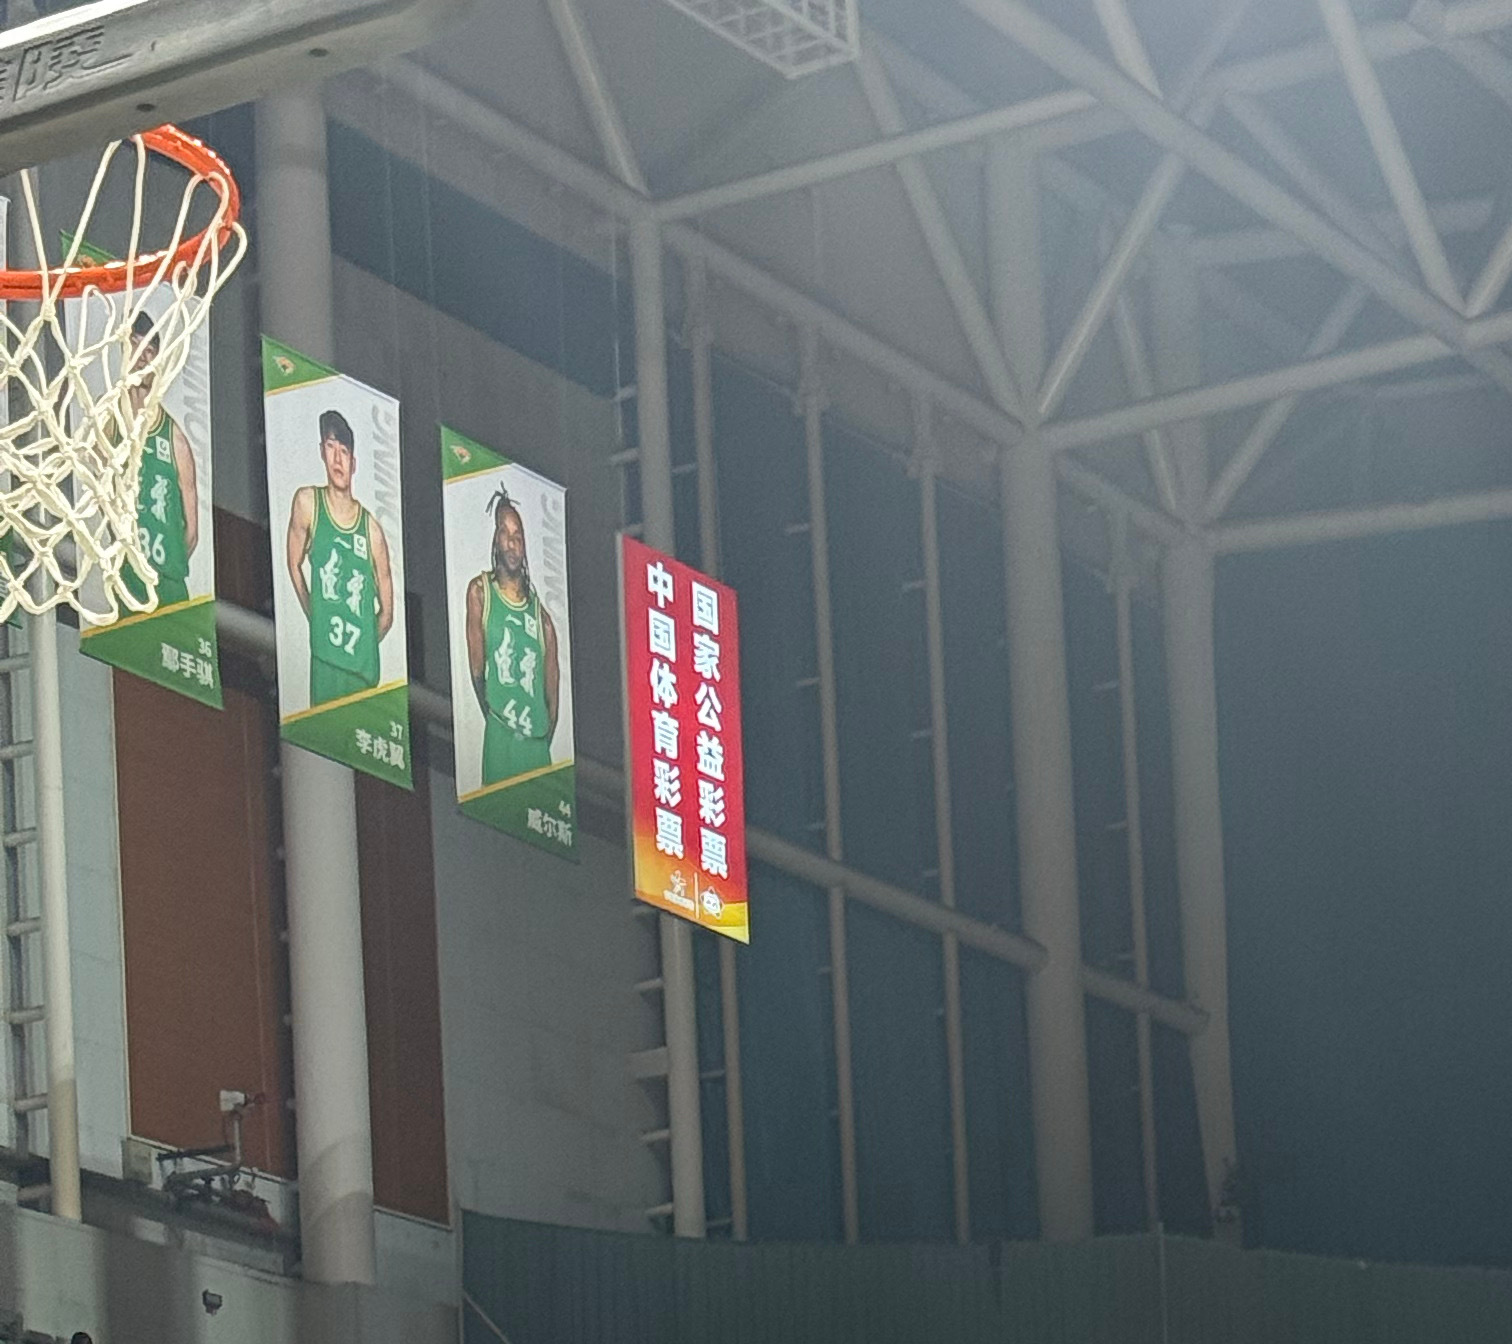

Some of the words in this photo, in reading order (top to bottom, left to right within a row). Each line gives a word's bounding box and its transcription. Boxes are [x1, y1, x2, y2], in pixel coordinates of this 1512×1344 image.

[328, 615, 361, 656] 37
[389, 721, 403, 741] 37
[503, 699, 532, 738] 44
[646, 561, 684, 860] 中国体育彩票
[691, 580, 728, 879] 国家公益彩票
